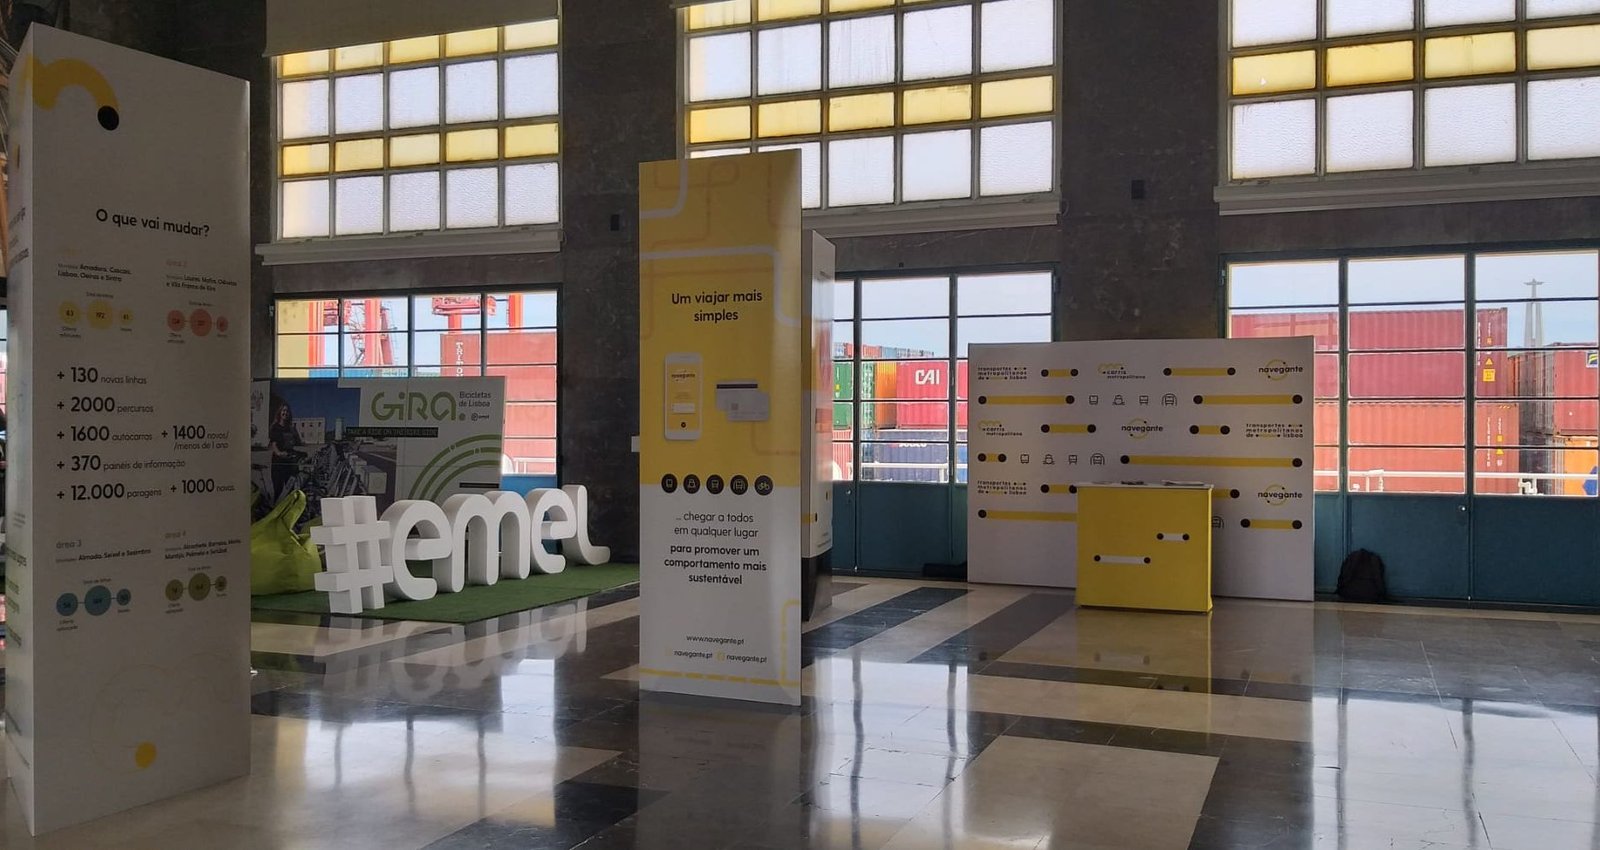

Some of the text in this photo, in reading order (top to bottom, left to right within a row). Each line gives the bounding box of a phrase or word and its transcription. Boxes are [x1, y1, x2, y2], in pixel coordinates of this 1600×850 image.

[96, 208, 210, 237] O que vai mudar?
[672, 289, 763, 306] Um viajar mais
[694, 310, 739, 324] simples
[70, 367, 98, 383] 130
[100, 376, 124, 384] novas
[125, 375, 147, 385] linhas
[1258, 366, 1303, 374] navegante
[915, 369, 940, 385] CAI
[459, 391, 491, 399] Bicicletas
[70, 397, 115, 413] 2000
[117, 404, 154, 414] percursos
[458, 399, 491, 407] de Lisboa
[70, 425, 110, 441] 1600
[112, 432, 152, 441] autocarros
[172, 425, 205, 440] 1400
[1121, 425, 1163, 433] navegante
[201, 442, 210, 450] de
[71, 455, 101, 472] 370
[132, 461, 143, 470] de
[71, 483, 125, 501] 12.000
[127, 488, 162, 499] paragens
[182, 478, 215, 494] 1000
[1257, 492, 1303, 500] navegante
[683, 511, 716, 523] chegar
[718, 514, 725, 522] a
[727, 512, 754, 523] todos
[674, 526, 758, 539] em qualquer lugar
[310, 484, 611, 614] #emel
[670, 544, 760, 556] para promover um
[664, 558, 767, 572] comportamento mais
[688, 573, 743, 585] sustentável
[686, 635, 744, 645] www.navegante.pt
[674, 650, 713, 659] navegante.pt
[726, 654, 767, 664] navegante.pt
